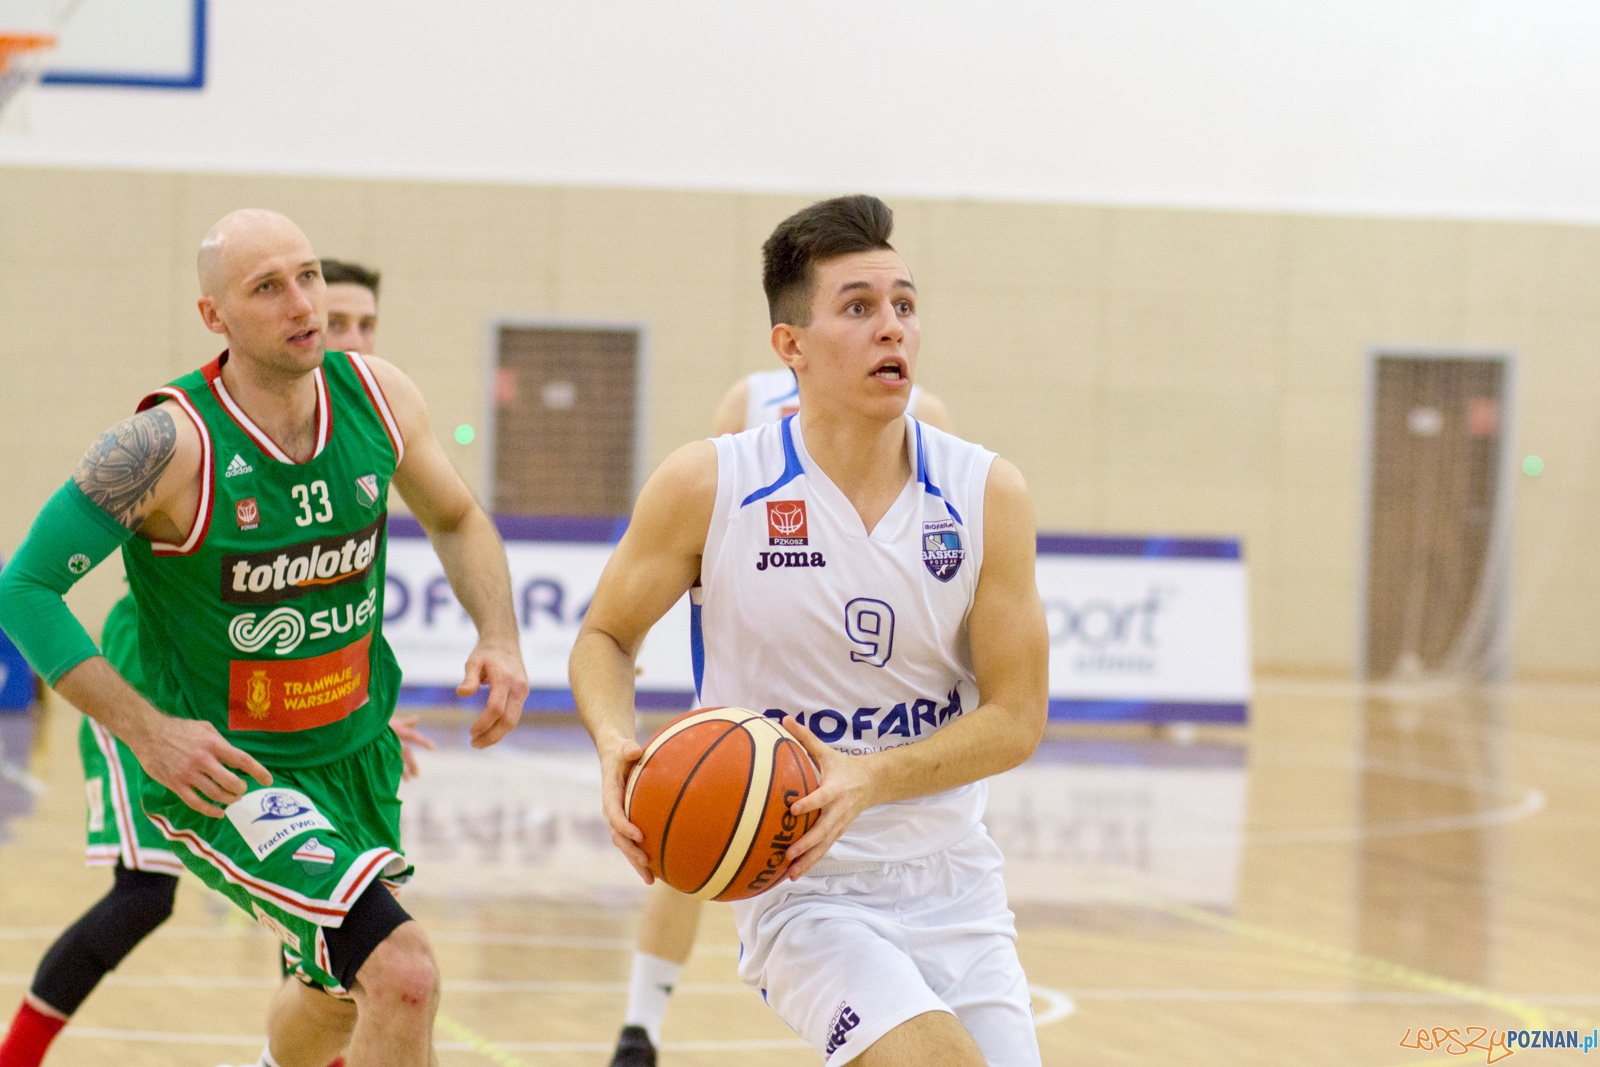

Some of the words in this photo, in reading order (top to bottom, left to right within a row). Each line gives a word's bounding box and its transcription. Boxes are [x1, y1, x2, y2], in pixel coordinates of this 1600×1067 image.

[225, 465, 253, 478] adidas
[291, 480, 333, 527] 33
[921, 549, 966, 561] BASKET
[845, 597, 895, 668] 9
[283, 666, 352, 696] TRAMWAJE
[257, 828, 291, 854] Fracht
[747, 789, 800, 890] molten
